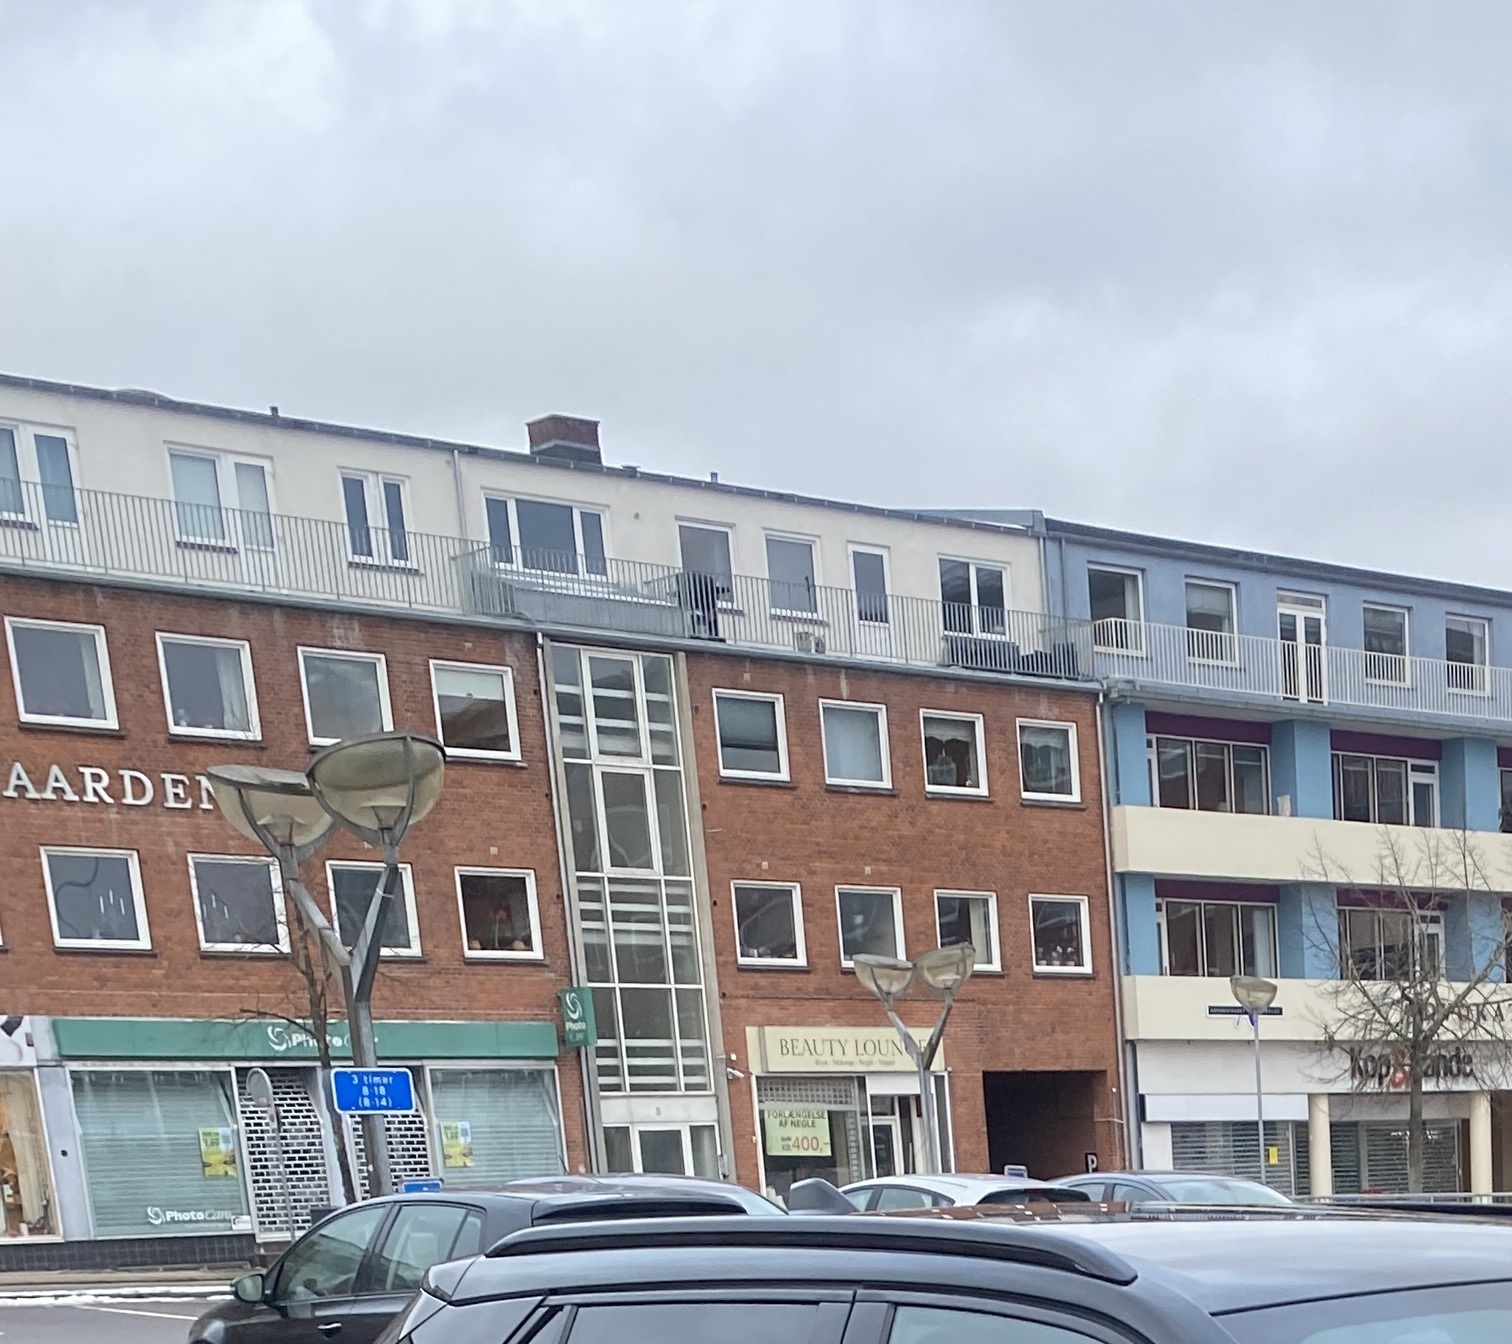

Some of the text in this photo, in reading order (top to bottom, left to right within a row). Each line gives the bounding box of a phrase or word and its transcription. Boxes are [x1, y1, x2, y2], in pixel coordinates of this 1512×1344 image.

[779, 1038, 927, 1057] BEAUTY LOUNE
[351, 1074, 393, 1085] 3 timer
[778, 1119, 816, 1128] AF NEGLE
[1087, 1154, 1097, 1173] P
